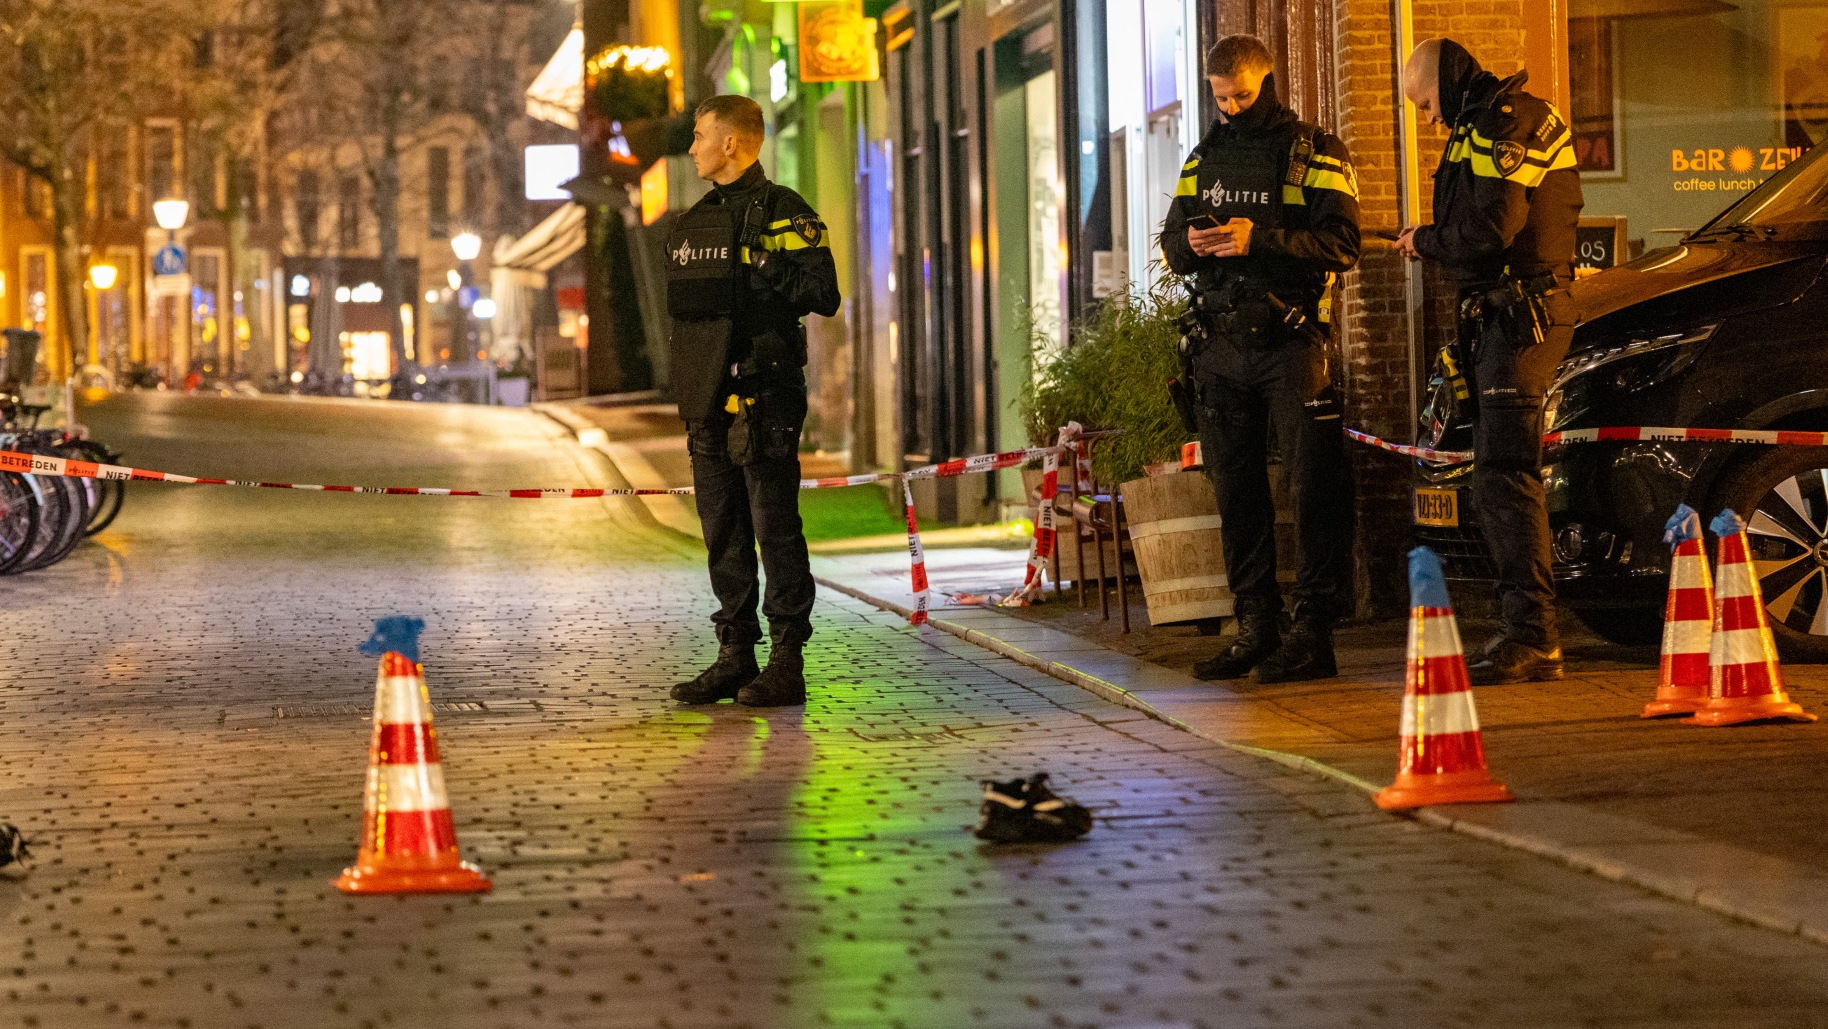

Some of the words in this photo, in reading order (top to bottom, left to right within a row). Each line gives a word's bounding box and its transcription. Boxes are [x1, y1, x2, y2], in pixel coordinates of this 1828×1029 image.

[1203, 180, 1269, 206] POLITIE
[1674, 178, 1716, 191] coffee
[1719, 178, 1756, 191] lunch
[672, 240, 728, 265] POLITIE
[1, 455, 57, 471] BETREDEN
[106, 471, 130, 480] NIET
[1043, 506, 1052, 528] NIET
[908, 536, 918, 557] NIET
